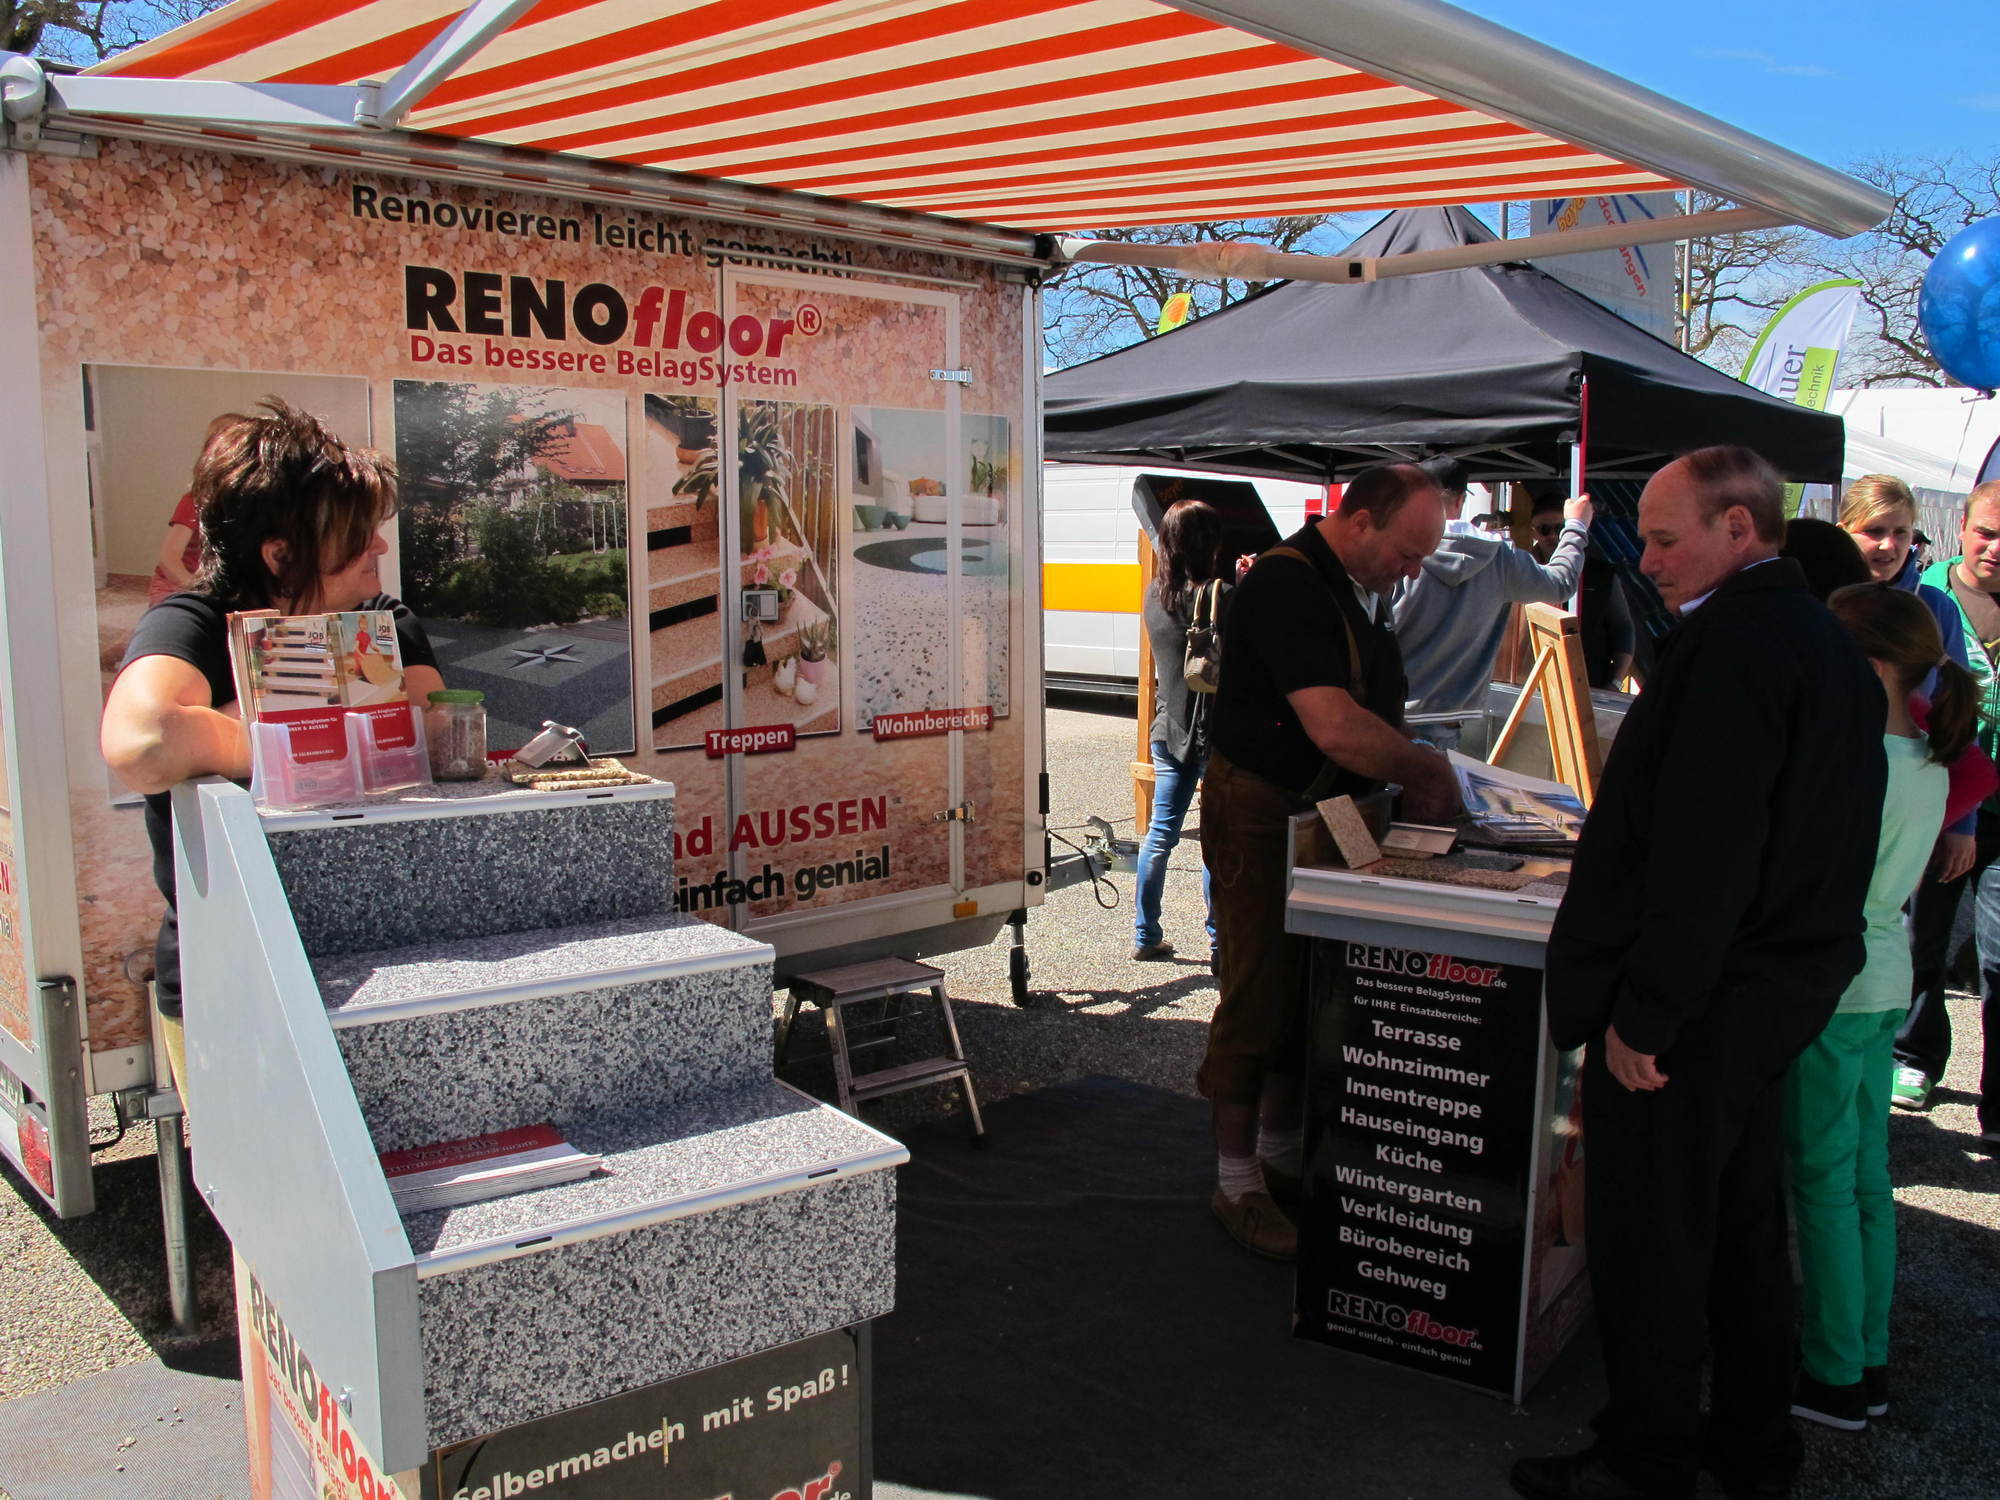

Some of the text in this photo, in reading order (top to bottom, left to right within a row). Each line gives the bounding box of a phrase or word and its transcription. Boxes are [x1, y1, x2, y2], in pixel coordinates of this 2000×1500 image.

[352, 184, 852, 278] Renovieren leicht gemacht!
[410, 335, 797, 387] Das bessere BelagSystem
[710, 728, 788, 751] Treppen
[877, 710, 990, 736] Wohnbereiche
[728, 795, 887, 853] AUSSEN
[794, 845, 890, 902] genial
[1353, 995, 1482, 1025] für IHRE Einsatzbereiche:
[1356, 976, 1482, 1005] Das bessere BelagSystem
[1371, 1019, 1462, 1051] Terrasse
[1342, 1045, 1490, 1088] Wohnzimmer
[1346, 1076, 1482, 1119] Innentreppe
[1340, 1106, 1484, 1155] Hauseingang
[1376, 1143, 1443, 1174] Küche
[1335, 1165, 1482, 1213] Wintergarten
[1340, 1196, 1474, 1246] Verkleidung
[1339, 1225, 1470, 1272] Bürobereich
[1357, 1260, 1447, 1300] Gehweg
[1326, 1321, 1356, 1335] genial
[1358, 1330, 1394, 1346] einfach
[1401, 1341, 1438, 1358] einfach
[1440, 1351, 1472, 1367] genial
[702, 1395, 754, 1432] mit
